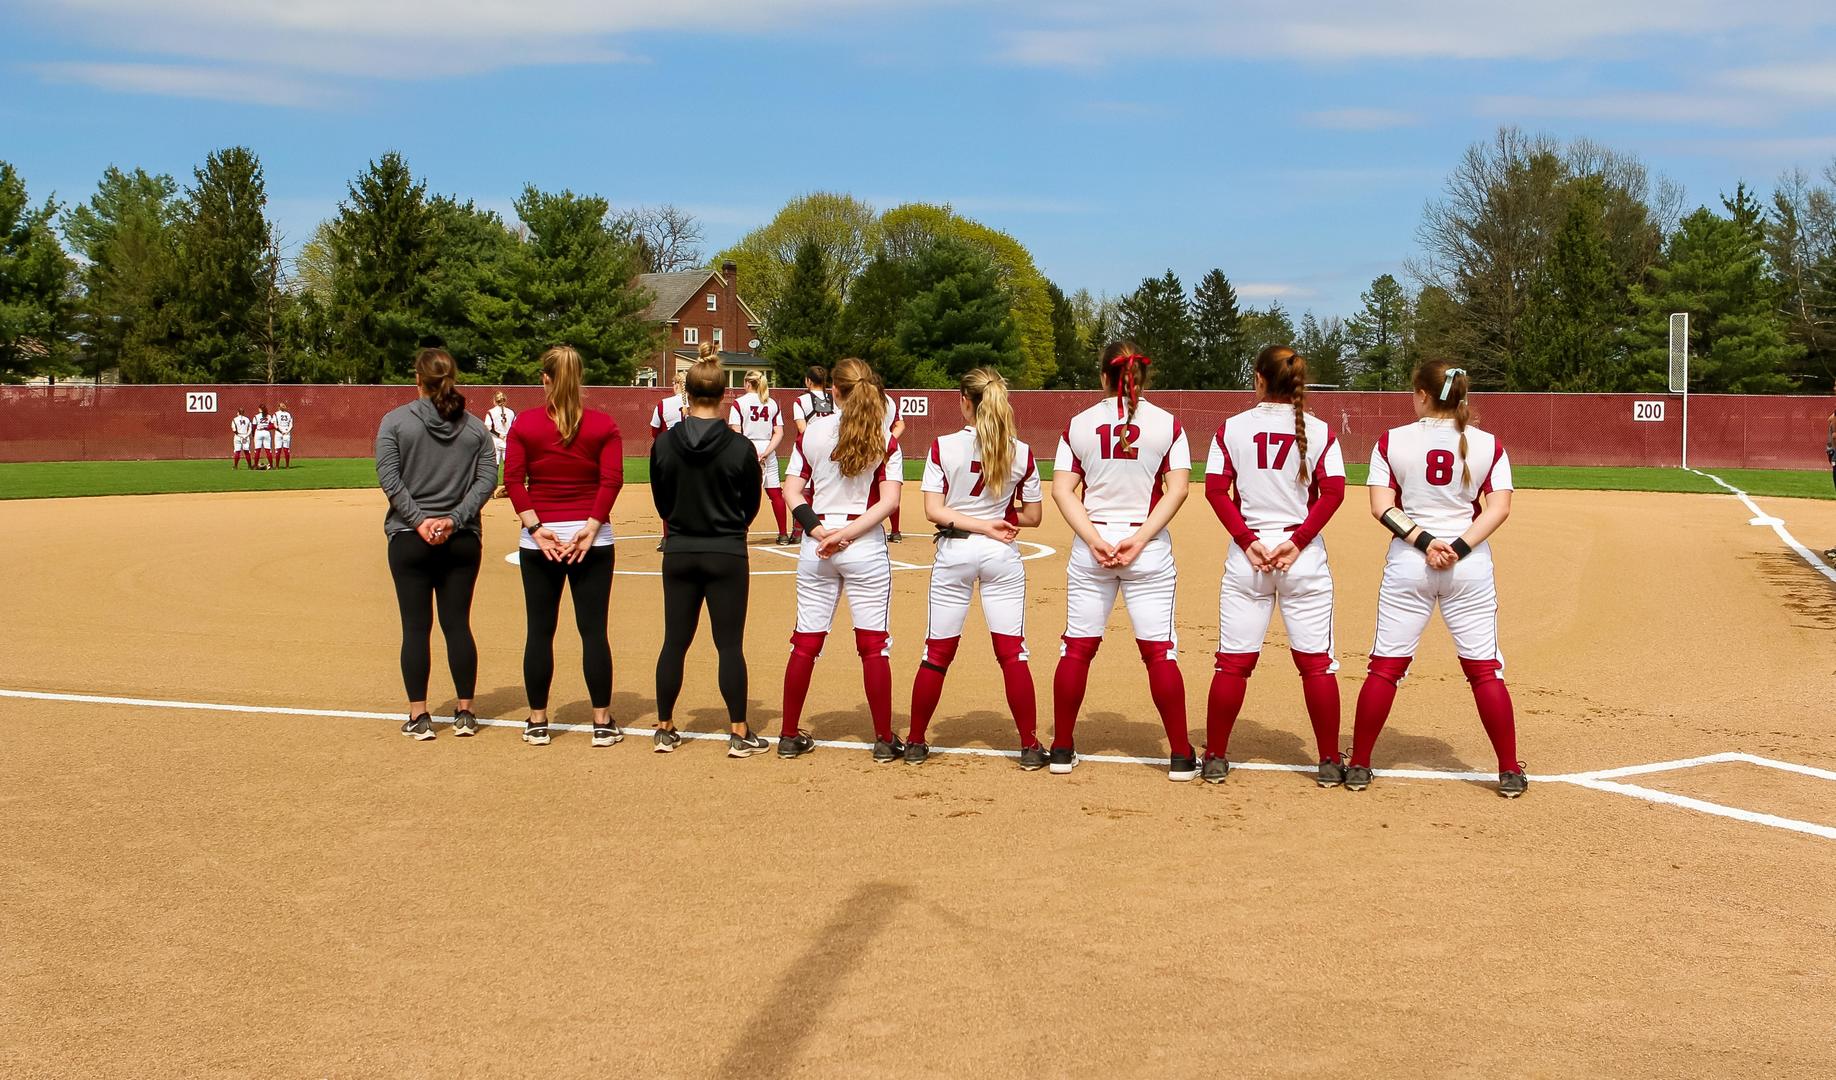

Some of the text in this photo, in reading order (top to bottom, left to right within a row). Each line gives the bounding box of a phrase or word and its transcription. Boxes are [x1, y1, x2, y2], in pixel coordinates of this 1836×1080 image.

[189, 395, 213, 410] 210
[750, 406, 769, 421] 34
[902, 399, 925, 413] 205
[1637, 404, 1661, 418] 200
[1096, 424, 1140, 460] 12
[1253, 432, 1297, 470] 17
[969, 461, 986, 496] 7
[1426, 449, 1454, 486] 8
